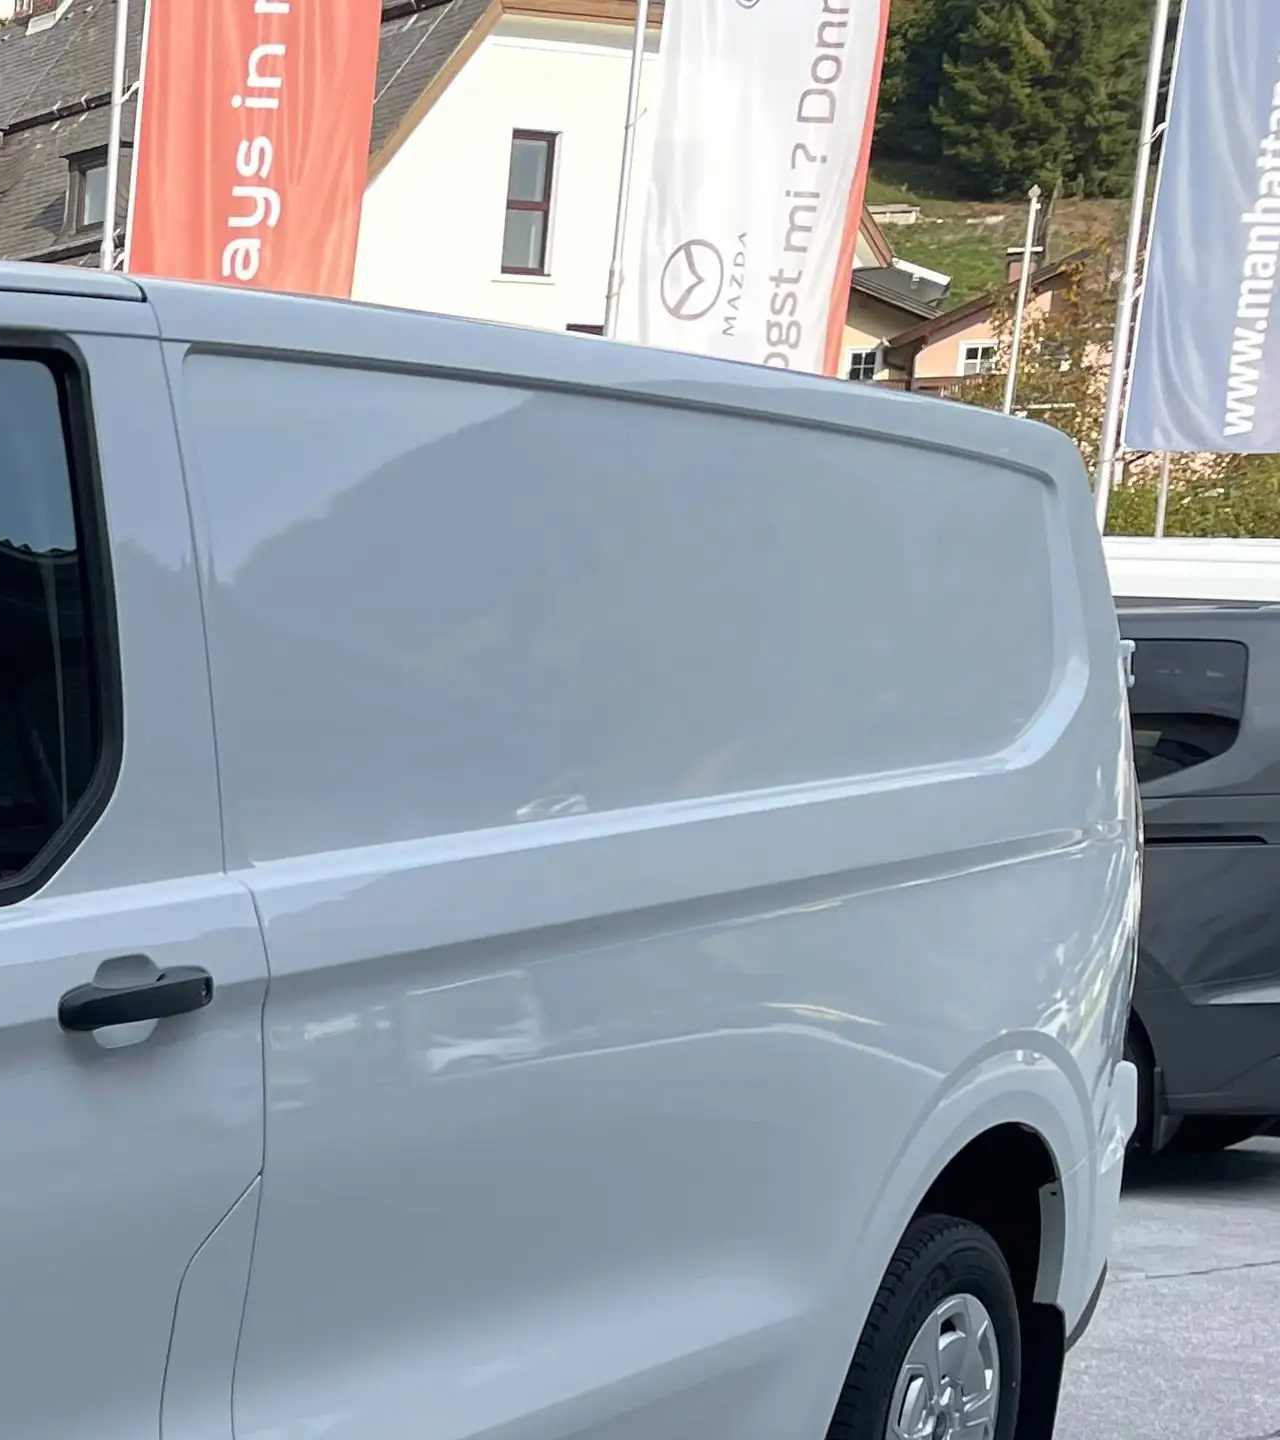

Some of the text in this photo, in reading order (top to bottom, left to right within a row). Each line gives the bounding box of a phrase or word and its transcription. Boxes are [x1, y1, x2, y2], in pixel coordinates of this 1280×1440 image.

[231, 44, 286, 110] in
[791, 143, 827, 171] ?
[222, 136, 280, 281] ays
[784, 190, 820, 254] mi
[722, 232, 748, 337] MAZDA
